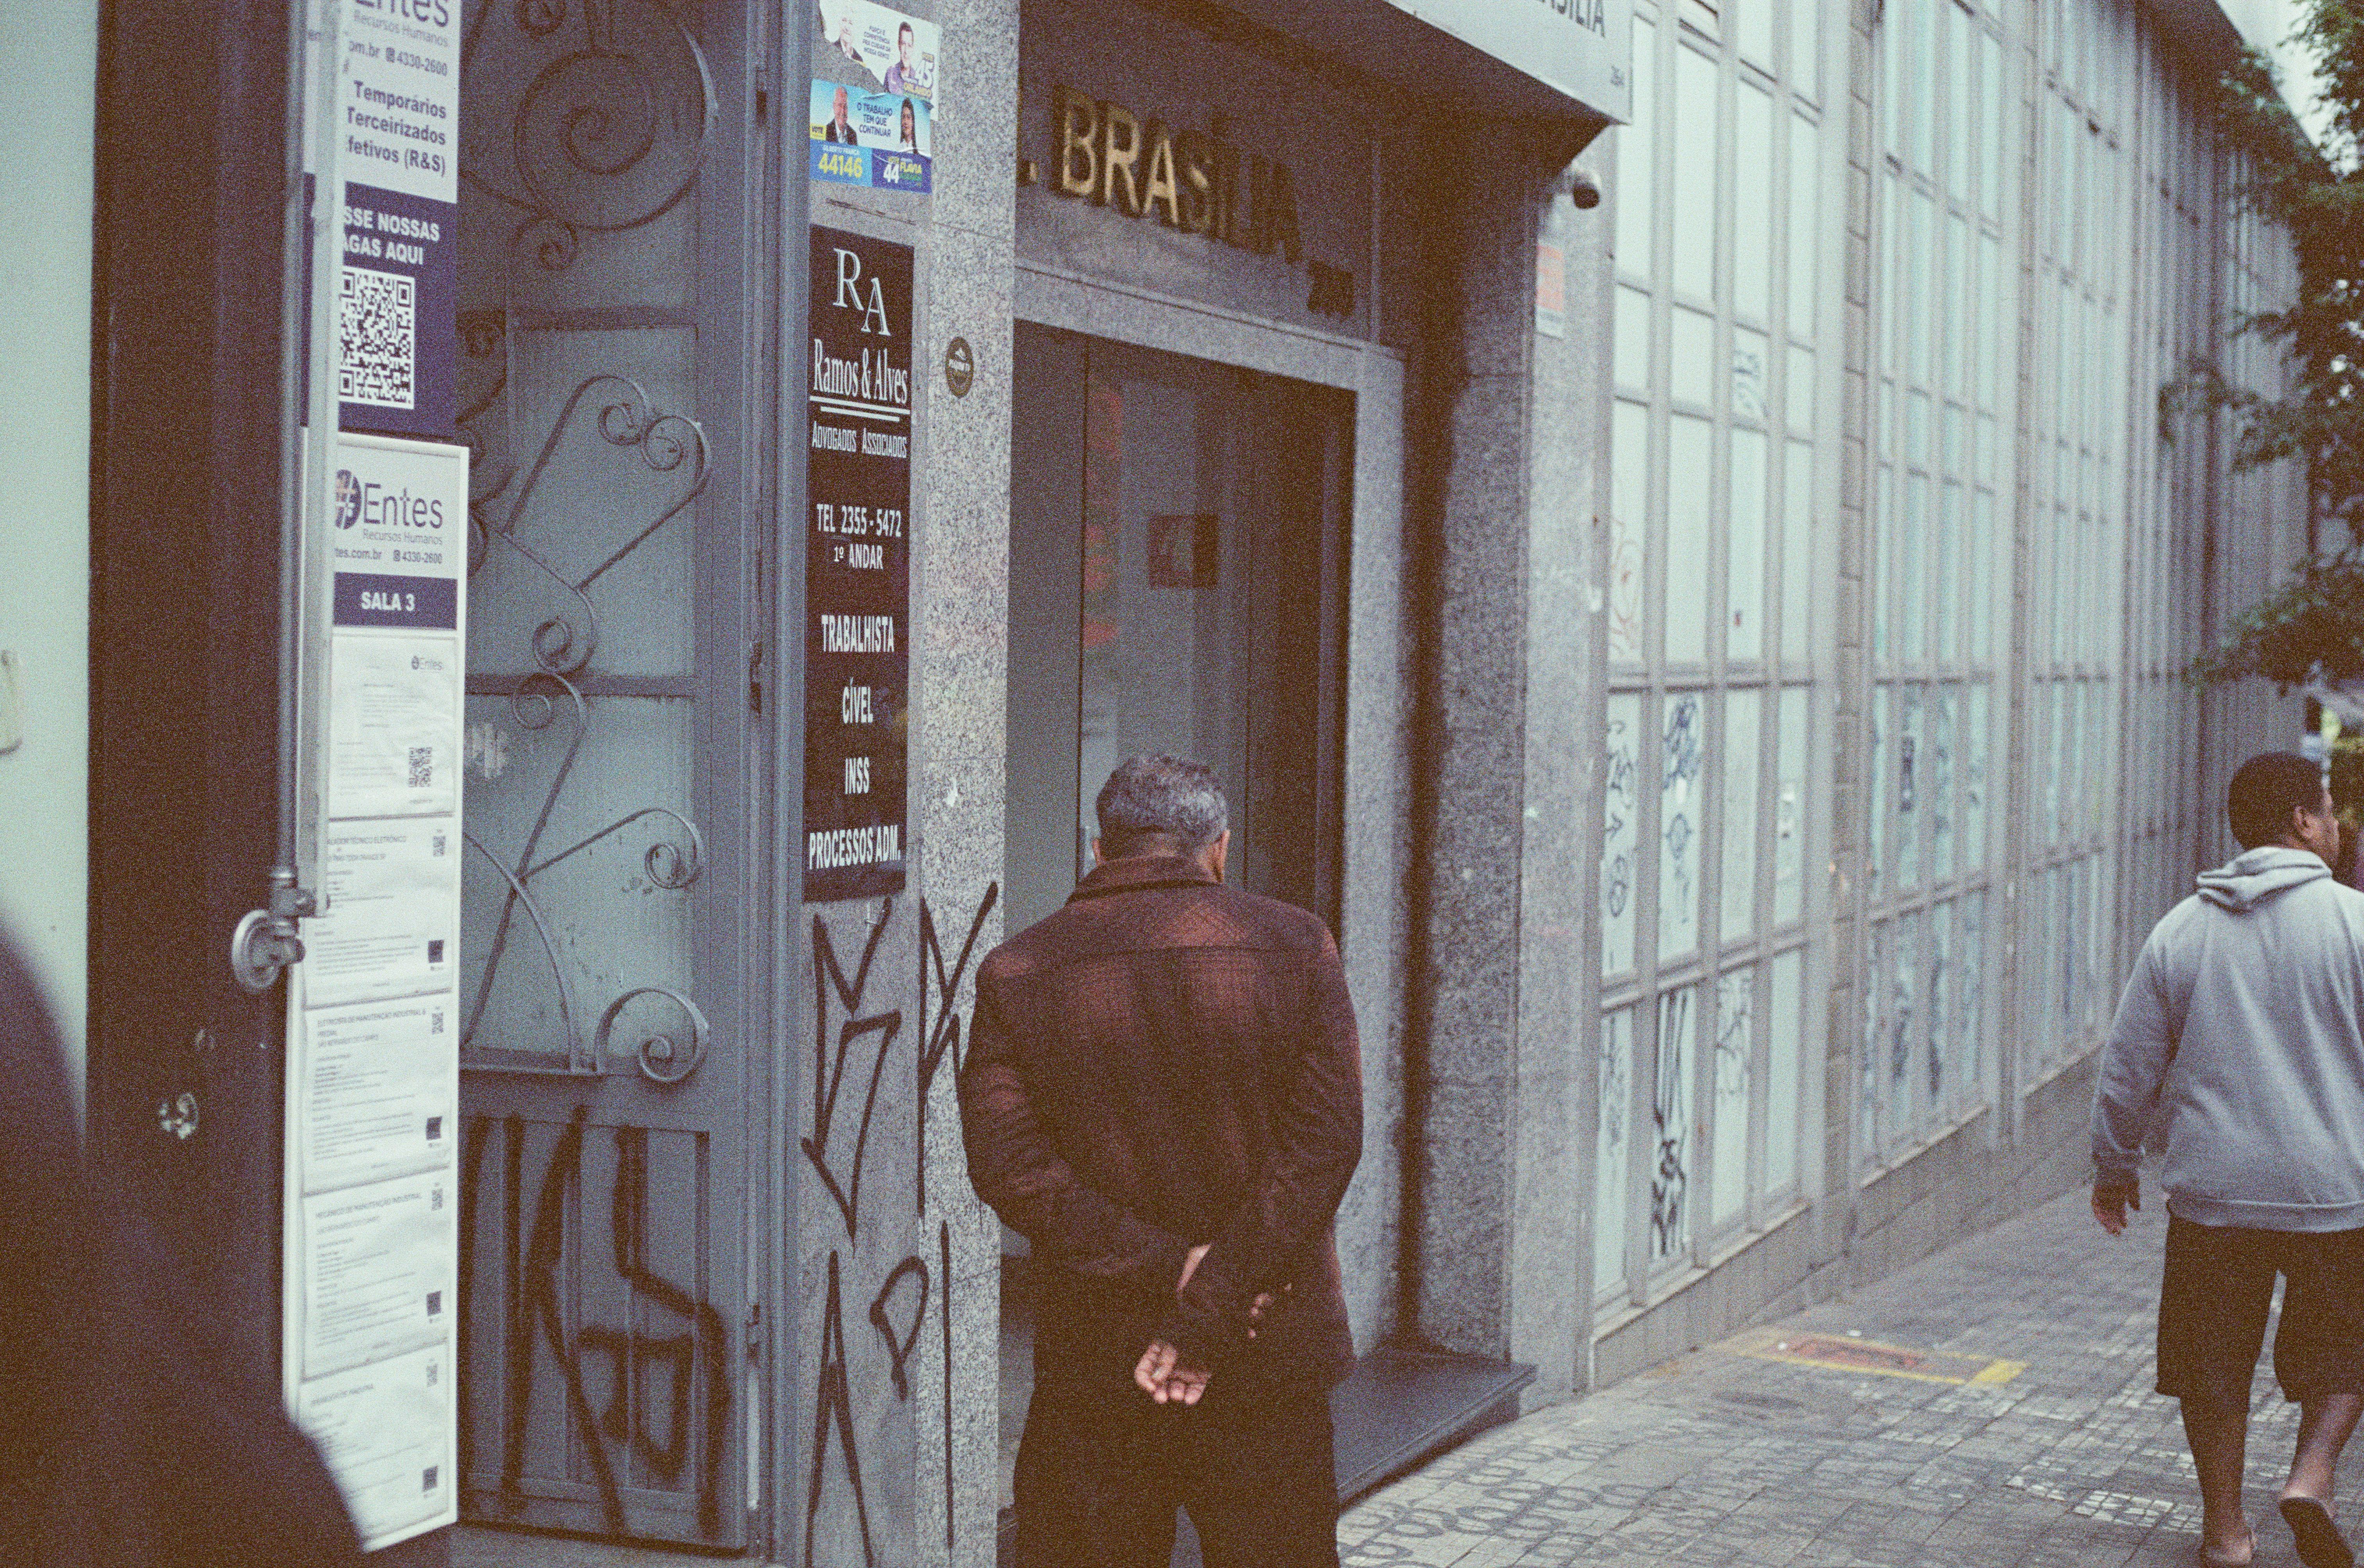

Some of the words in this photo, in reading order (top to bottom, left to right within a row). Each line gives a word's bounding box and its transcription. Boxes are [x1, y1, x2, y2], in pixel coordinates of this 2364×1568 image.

[914, 60, 934, 89] 45
[354, 80, 446, 119] Temporários
[857, 102, 862, 111] O
[863, 102, 893, 116] TRABALHO
[347, 106, 446, 145] Terceirizados
[859, 124, 891, 137] CONTINUAR
[863, 115, 874, 124] TEM
[875, 116, 887, 126] QUE
[404, 148, 446, 177] (R&S)
[818, 153, 863, 179] 44146
[883, 164, 899, 184] 44
[377, 213, 440, 242] NOSSAS
[385, 241, 424, 265] AQUI
[813, 339, 858, 397] Ramos
[861, 347, 872, 400] &
[873, 348, 908, 404] Alves
[363, 482, 443, 529] Entes
[816, 504, 835, 533] TEL
[363, 528, 401, 542] Recursos
[403, 531, 443, 546] Humanos
[402, 550, 443, 565] 4330-2600
[848, 543, 884, 569] ANDAR
[361, 592, 401, 611] SALA
[405, 593, 415, 611] 3
[821, 615, 895, 653] TRABALHISTA
[845, 757, 869, 795] INSS
[809, 827, 874, 870] PROCESSOS
[875, 824, 901, 862] ADM.
